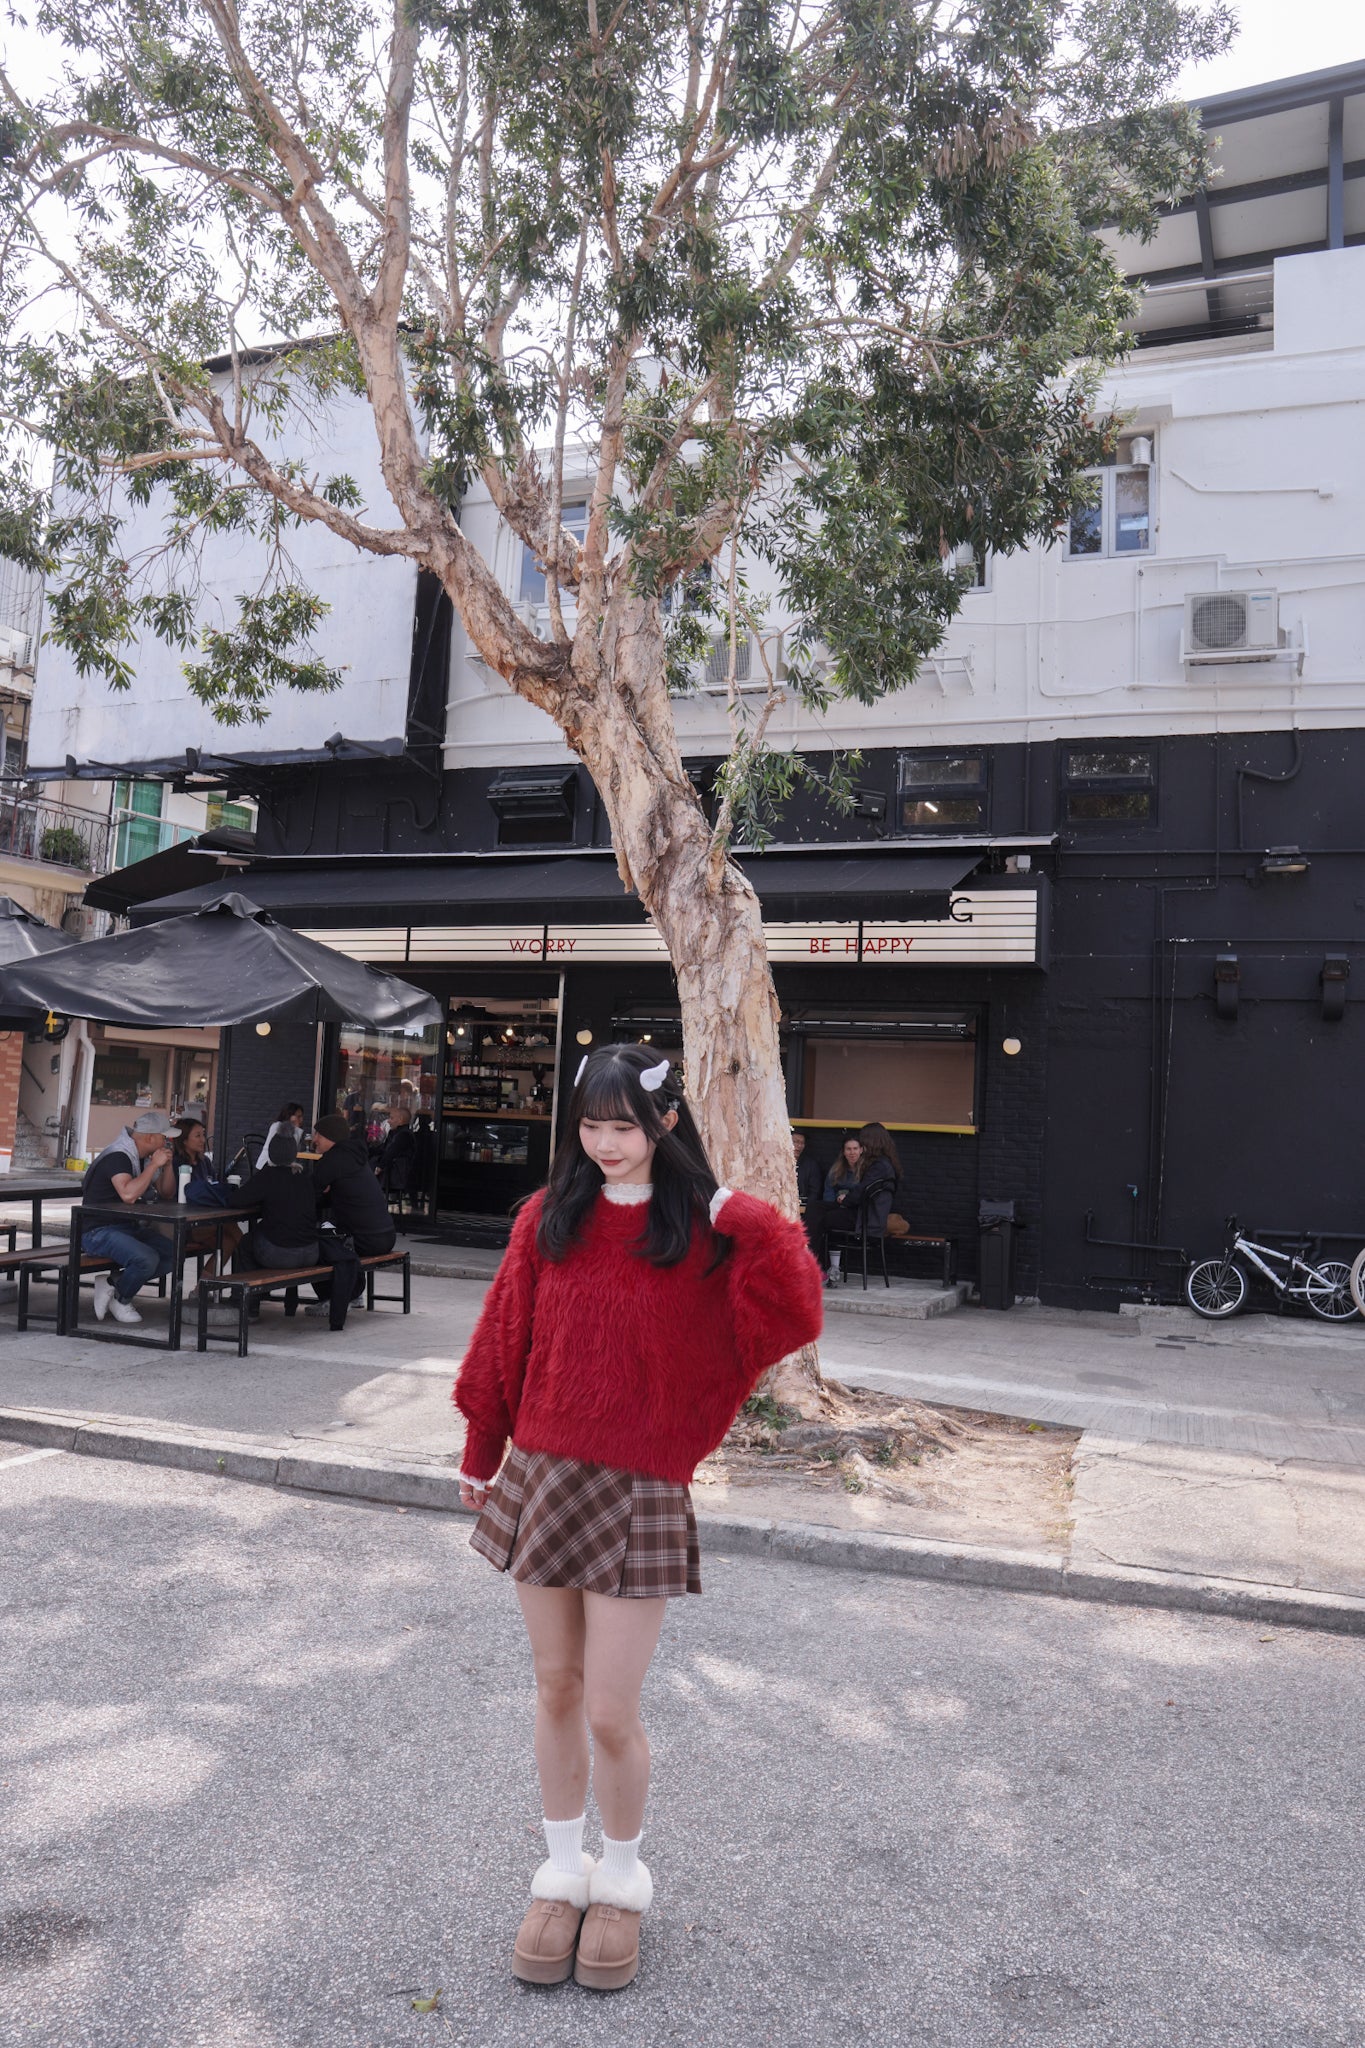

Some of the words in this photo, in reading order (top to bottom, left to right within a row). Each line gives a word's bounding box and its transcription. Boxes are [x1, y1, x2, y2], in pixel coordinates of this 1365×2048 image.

[509, 939, 577, 954] WORRY
[809, 937, 831, 954] BE
[845, 937, 915, 955] HAPPY
